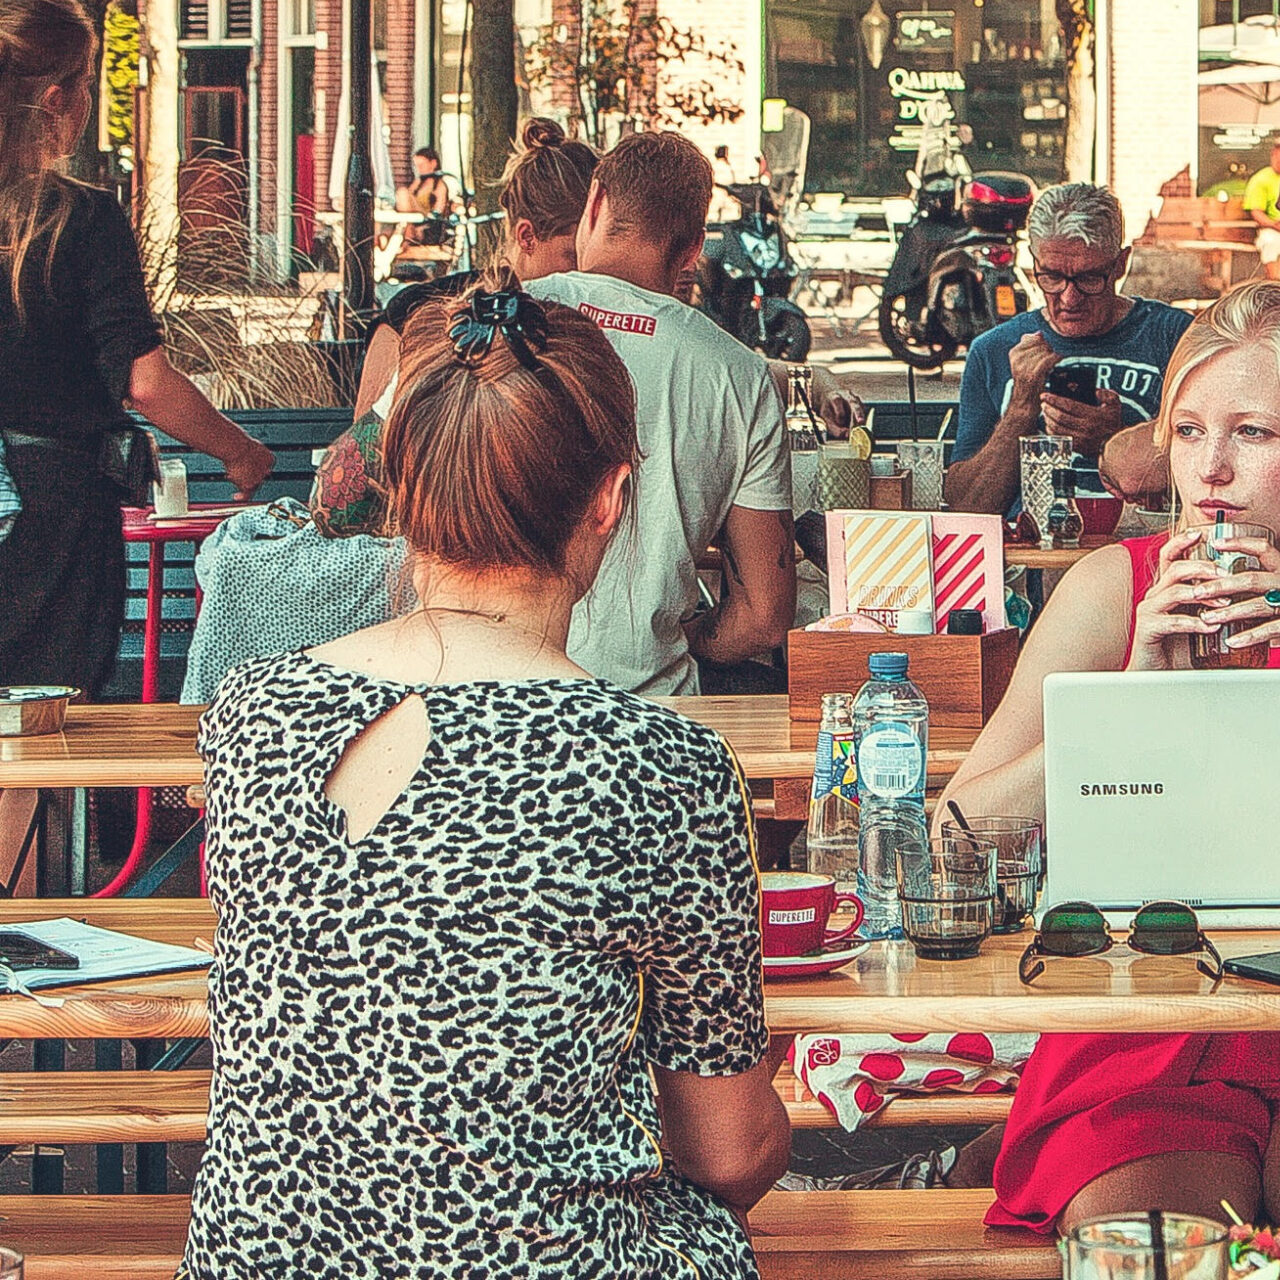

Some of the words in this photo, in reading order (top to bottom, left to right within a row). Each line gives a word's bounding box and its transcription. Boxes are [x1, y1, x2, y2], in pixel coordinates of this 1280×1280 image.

[859, 585, 919, 608] DRINKS
[1080, 783, 1164, 797] SAMSUNG
[770, 909, 814, 923] SUPERETTE
